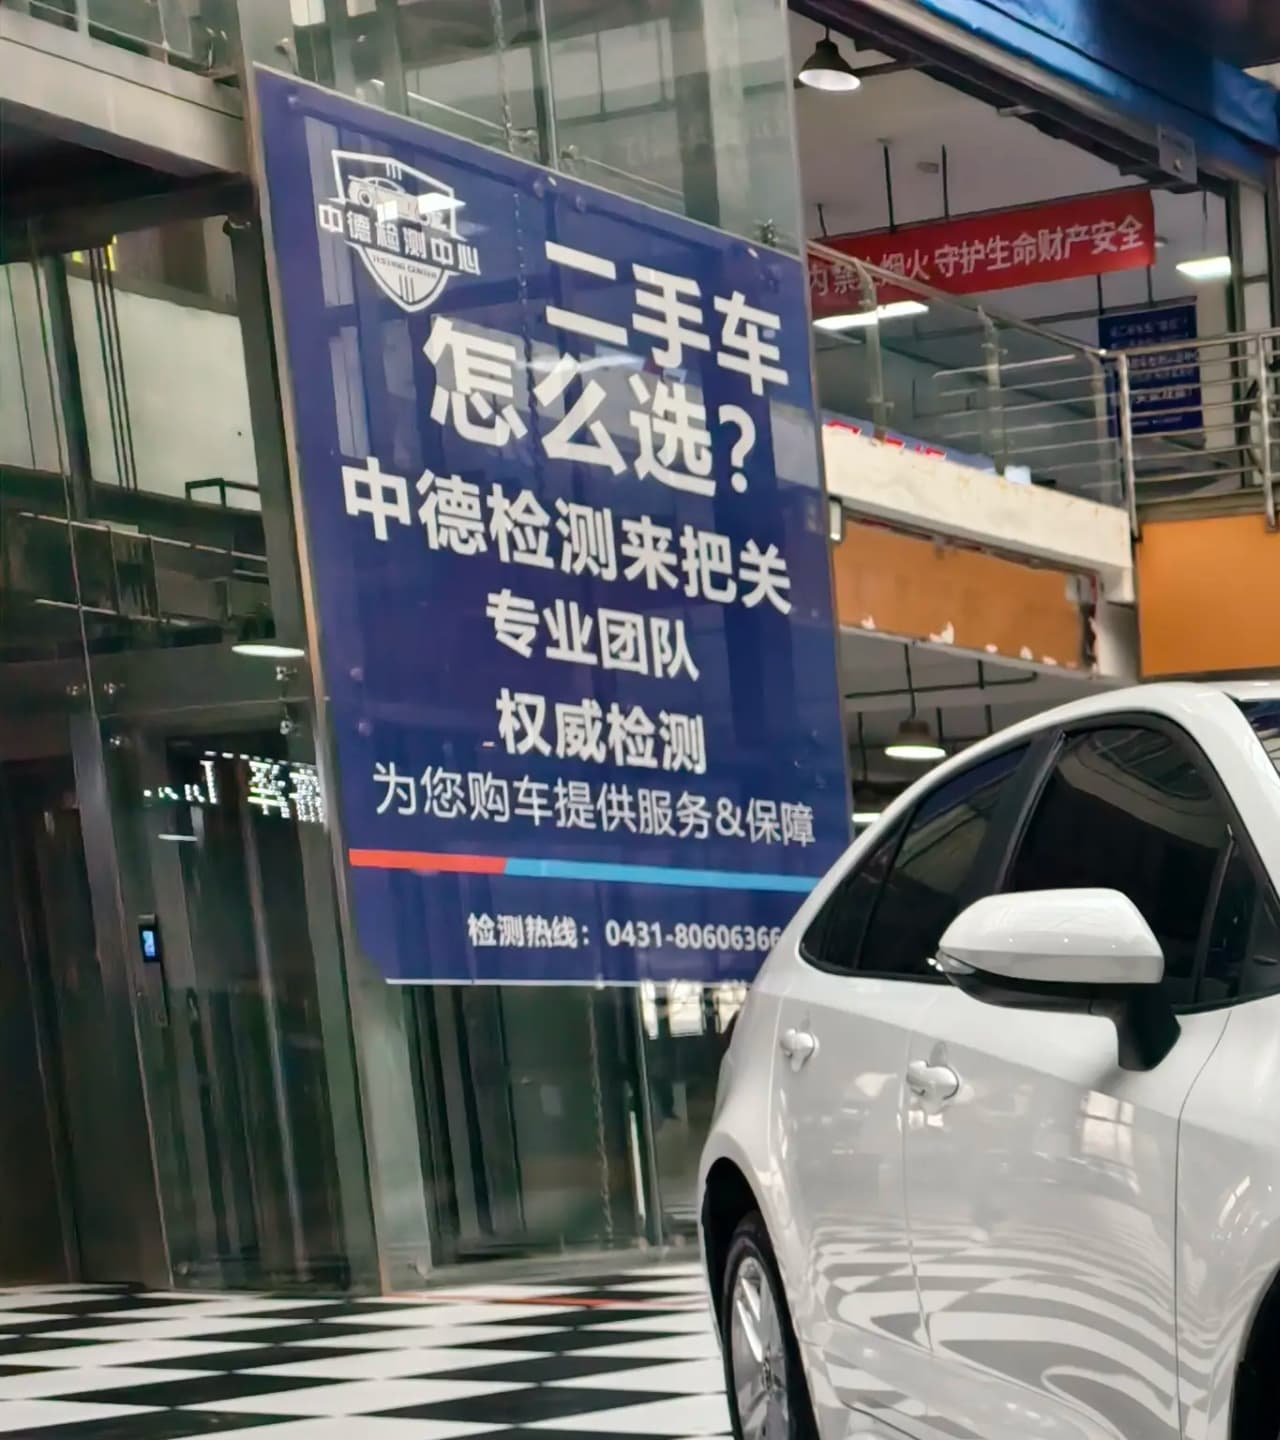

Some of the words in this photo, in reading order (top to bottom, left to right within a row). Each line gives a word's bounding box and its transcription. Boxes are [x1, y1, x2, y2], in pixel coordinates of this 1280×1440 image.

[318, 203, 481, 276] 中德检测中心
[934, 214, 1145, 278] 守护生命财产安全
[544, 240, 789, 397] 二手车
[340, 456, 793, 615] 中德检测来把关
[486, 588, 700, 682] 专业团队
[496, 687, 707, 775] 权威检测
[372, 762, 817, 847] 为您购车提供服务&保障
